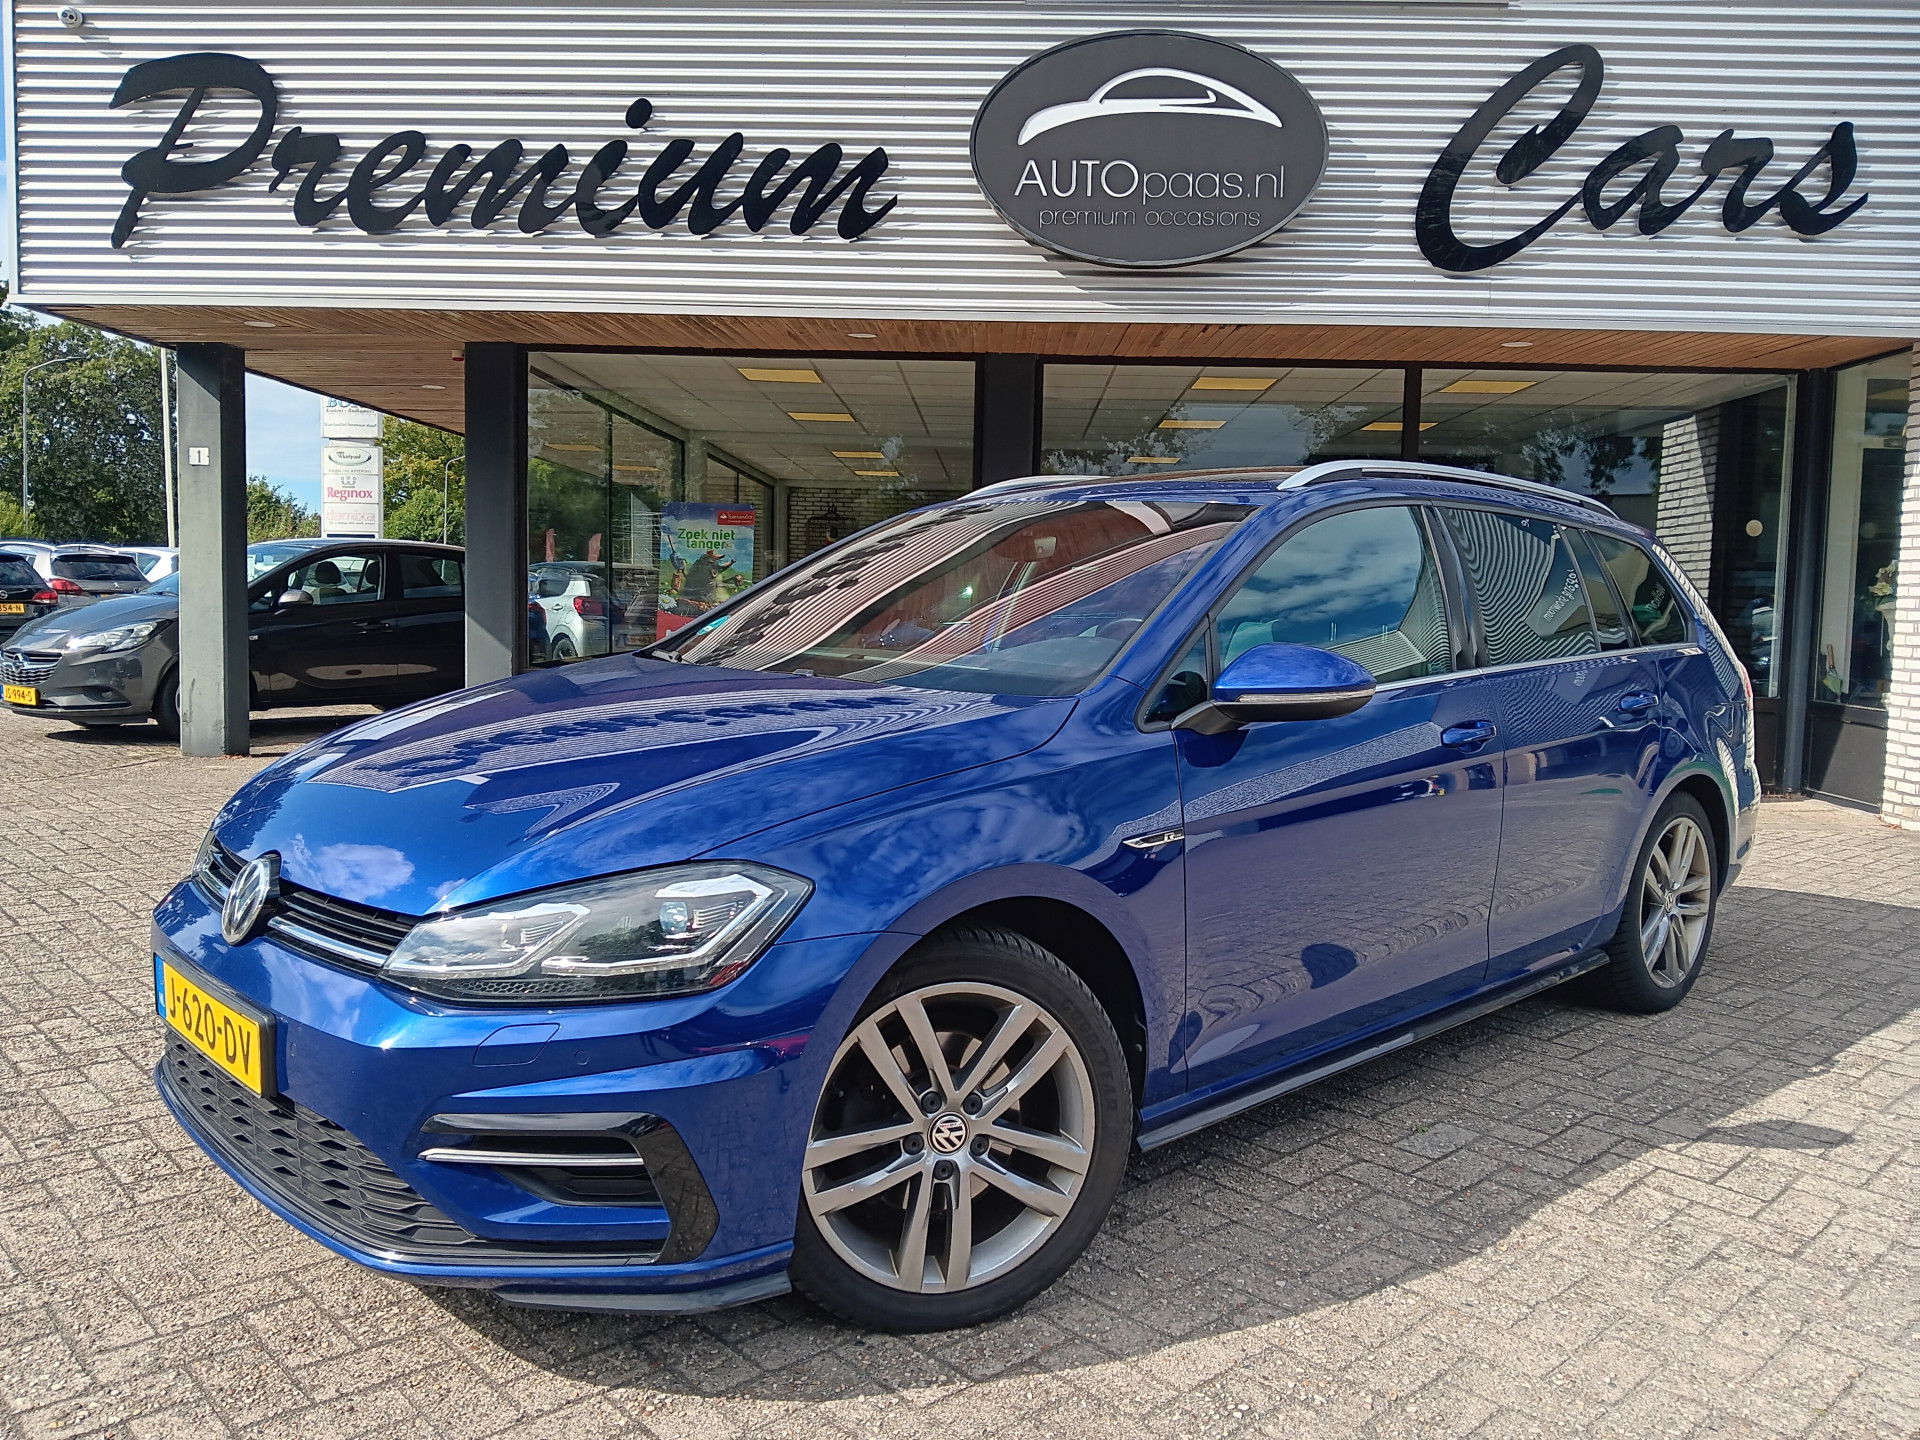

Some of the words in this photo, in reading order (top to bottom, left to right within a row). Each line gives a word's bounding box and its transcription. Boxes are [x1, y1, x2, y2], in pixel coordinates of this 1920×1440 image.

[109, 51, 899, 249] Premium
[1414, 43, 1869, 273] Cars
[1014, 159, 1285, 205] AUTOpaas.nl
[1039, 206, 1136, 228] premium
[1144, 206, 1261, 227] occasions
[196, 449, 202, 463] 1
[327, 486, 373, 502] Reginox
[711, 529, 736, 540] niet
[169, 976, 252, 1077] J-620-DV
